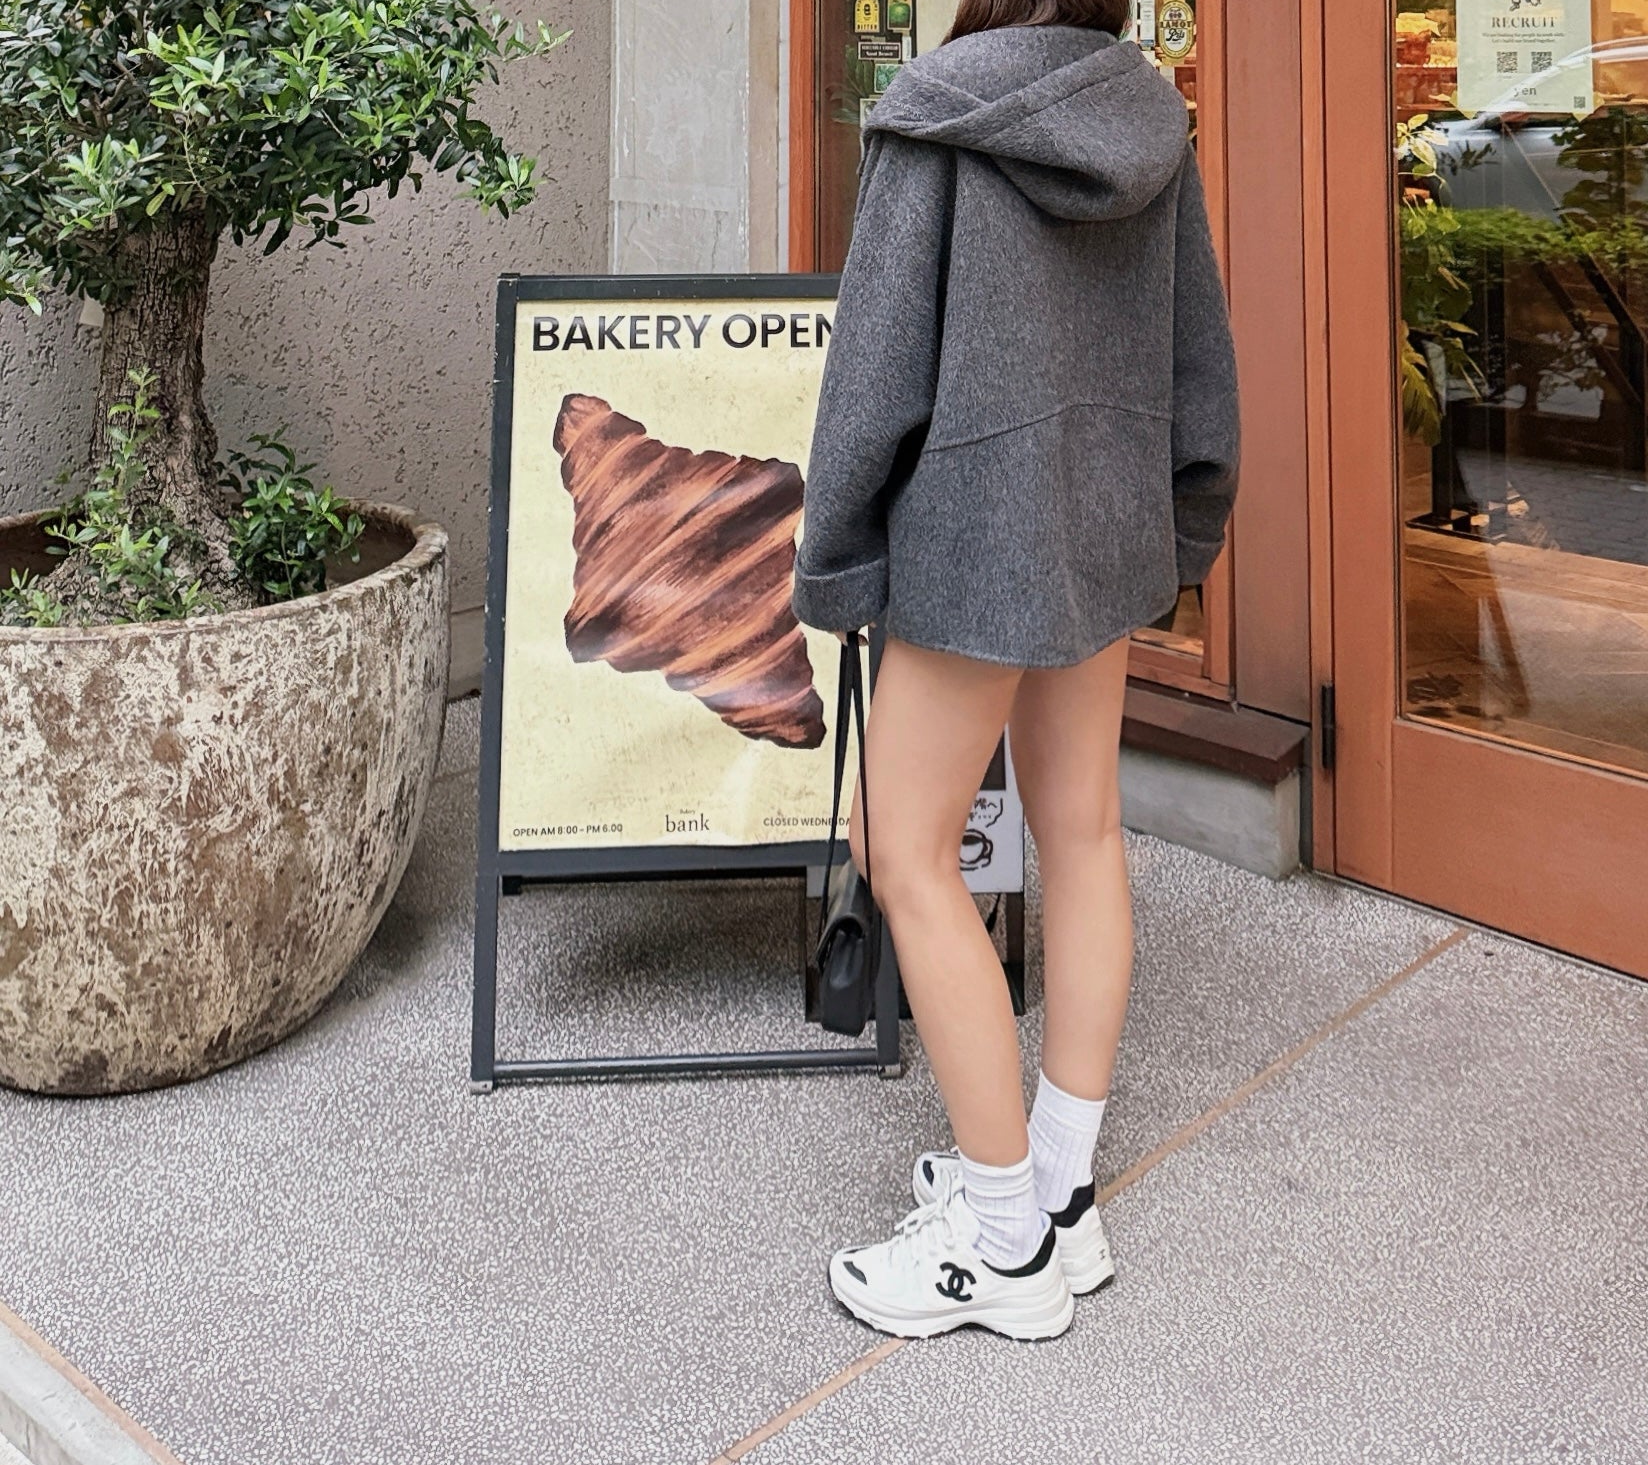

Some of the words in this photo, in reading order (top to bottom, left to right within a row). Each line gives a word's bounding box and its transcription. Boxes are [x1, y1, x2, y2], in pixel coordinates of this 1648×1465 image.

[1492, 17, 1556, 28] RECRUIT
[532, 314, 712, 352] BAKERY
[665, 813, 710, 833] bank
[763, 817, 799, 827] CLOSED
[513, 827, 538, 837] OPEN
[540, 827, 556, 836] AM
[557, 826, 578, 835] 8:00
[586, 825, 600, 834] PM
